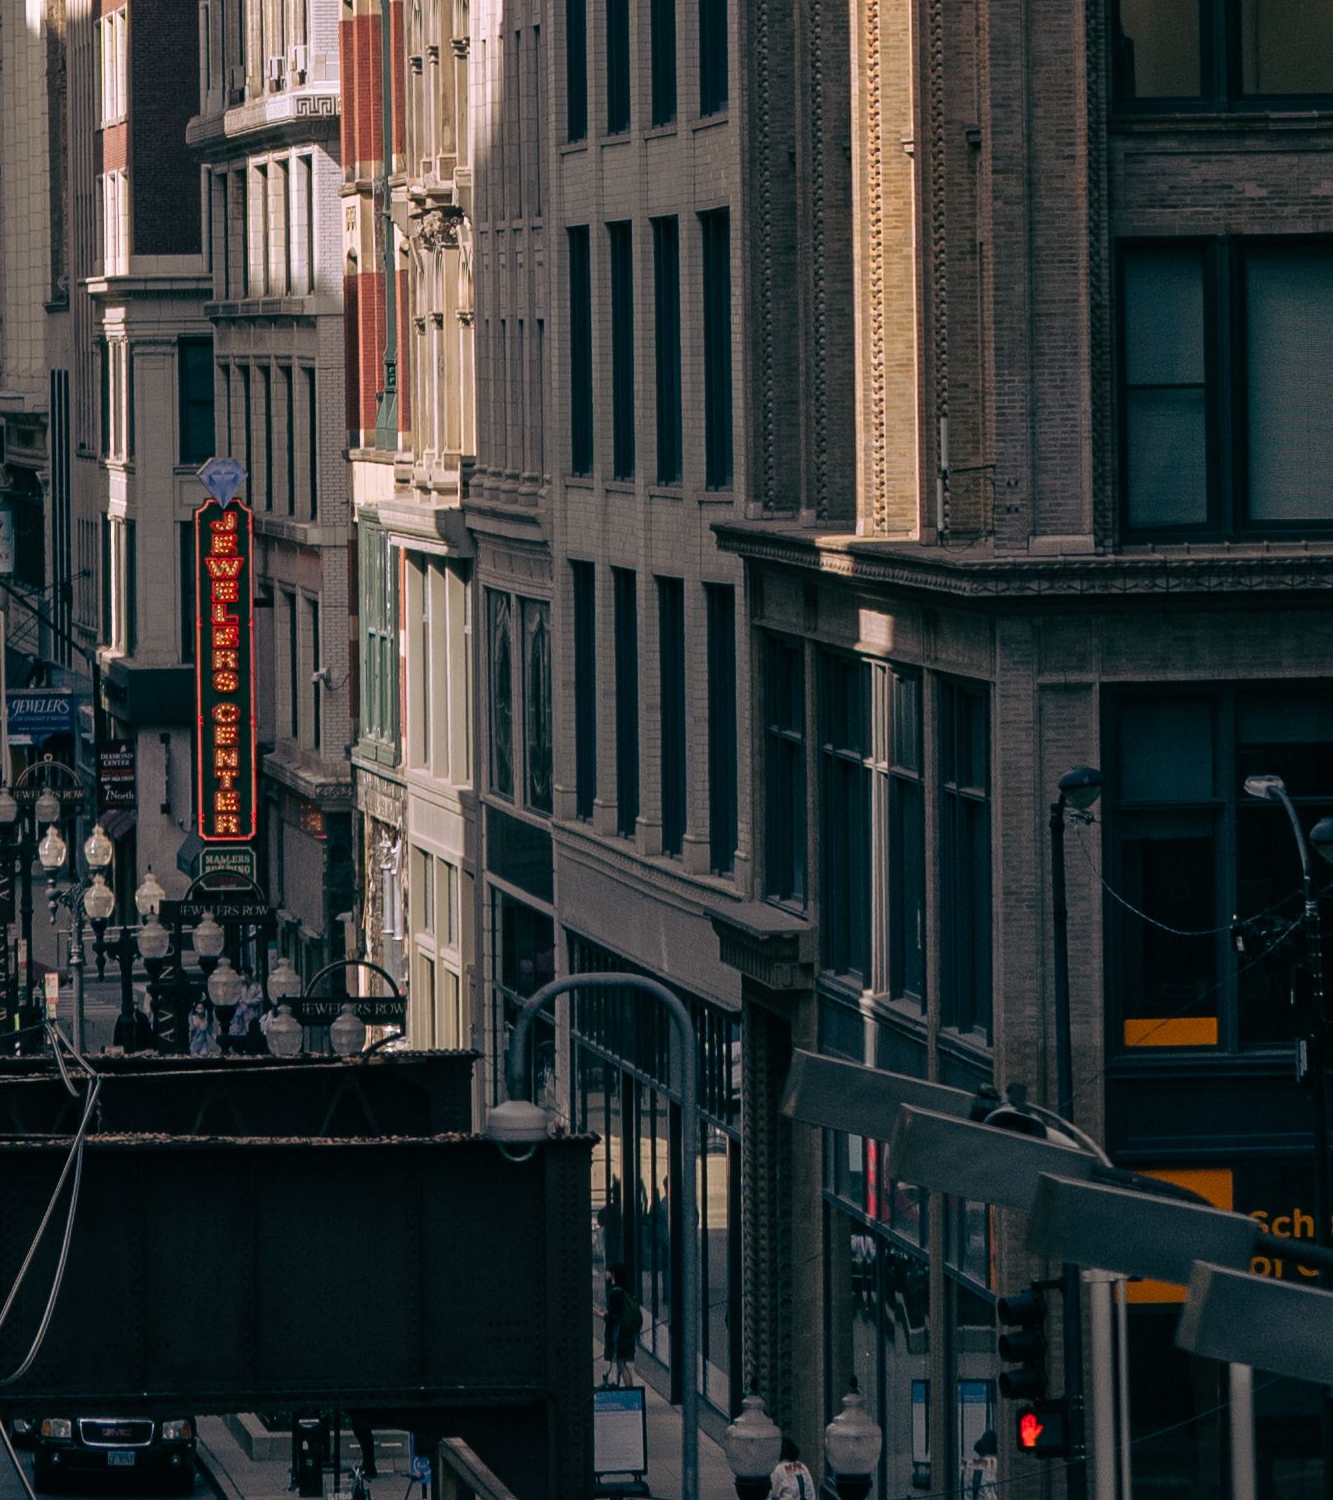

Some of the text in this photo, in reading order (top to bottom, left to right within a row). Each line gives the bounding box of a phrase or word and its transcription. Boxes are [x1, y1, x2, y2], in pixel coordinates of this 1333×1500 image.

[203, 510, 245, 693] JEWELERS
[11, 698, 70, 718] JEWELERS
[100, 752, 134, 760] DIAMOND
[102, 759, 131, 767] CENTER
[210, 702, 242, 835] CENTER
[13, 789, 61, 799] JEWELS
[241, 904, 270, 917] ROW
[302, 1002, 406, 1015] JEWELRS ROW
